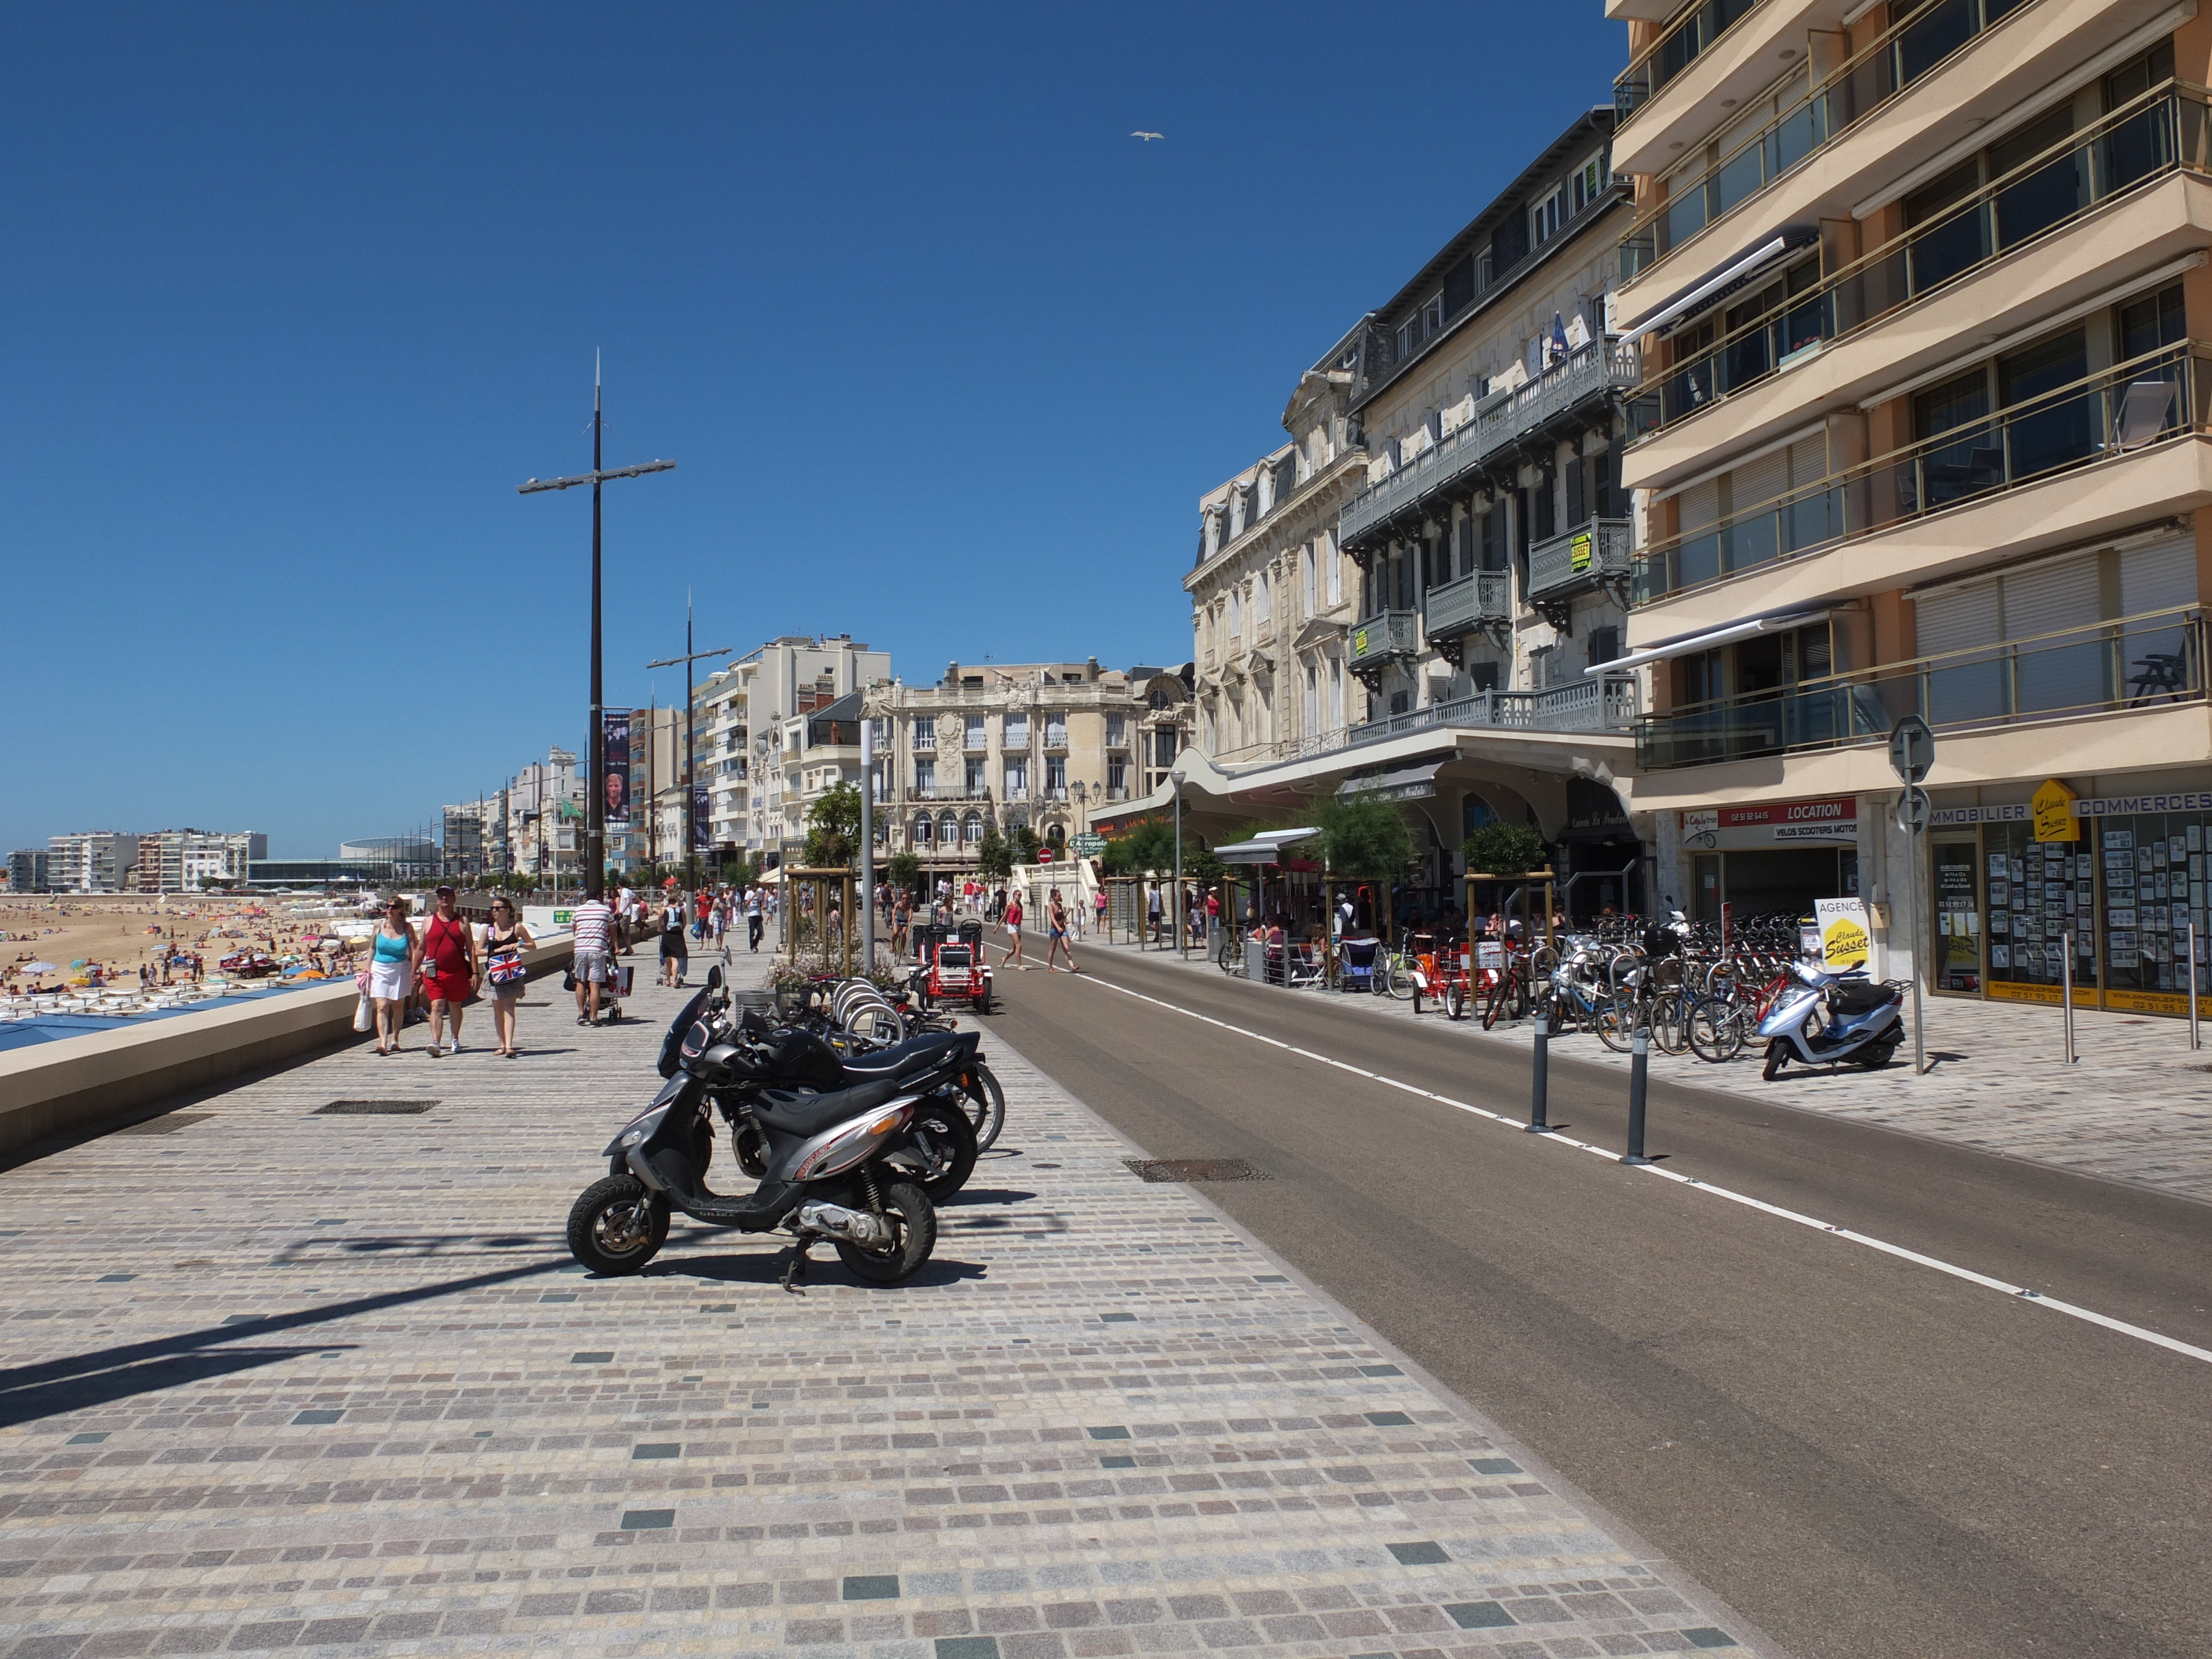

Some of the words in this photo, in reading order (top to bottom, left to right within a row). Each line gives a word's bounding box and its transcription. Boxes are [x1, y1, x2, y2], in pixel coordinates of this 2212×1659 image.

[1788, 803, 1841, 820] LOCATION
[2079, 794, 2212, 815] COMMERCES
[1929, 805, 2025, 824] MMOBILIER
[1776, 828, 1796, 836] VELOS
[1798, 826, 1832, 836] SCOOTERS
[1820, 901, 1864, 912] AGENCE
[1836, 929, 1864, 943] Claude
[1824, 936, 1869, 960] Susset
